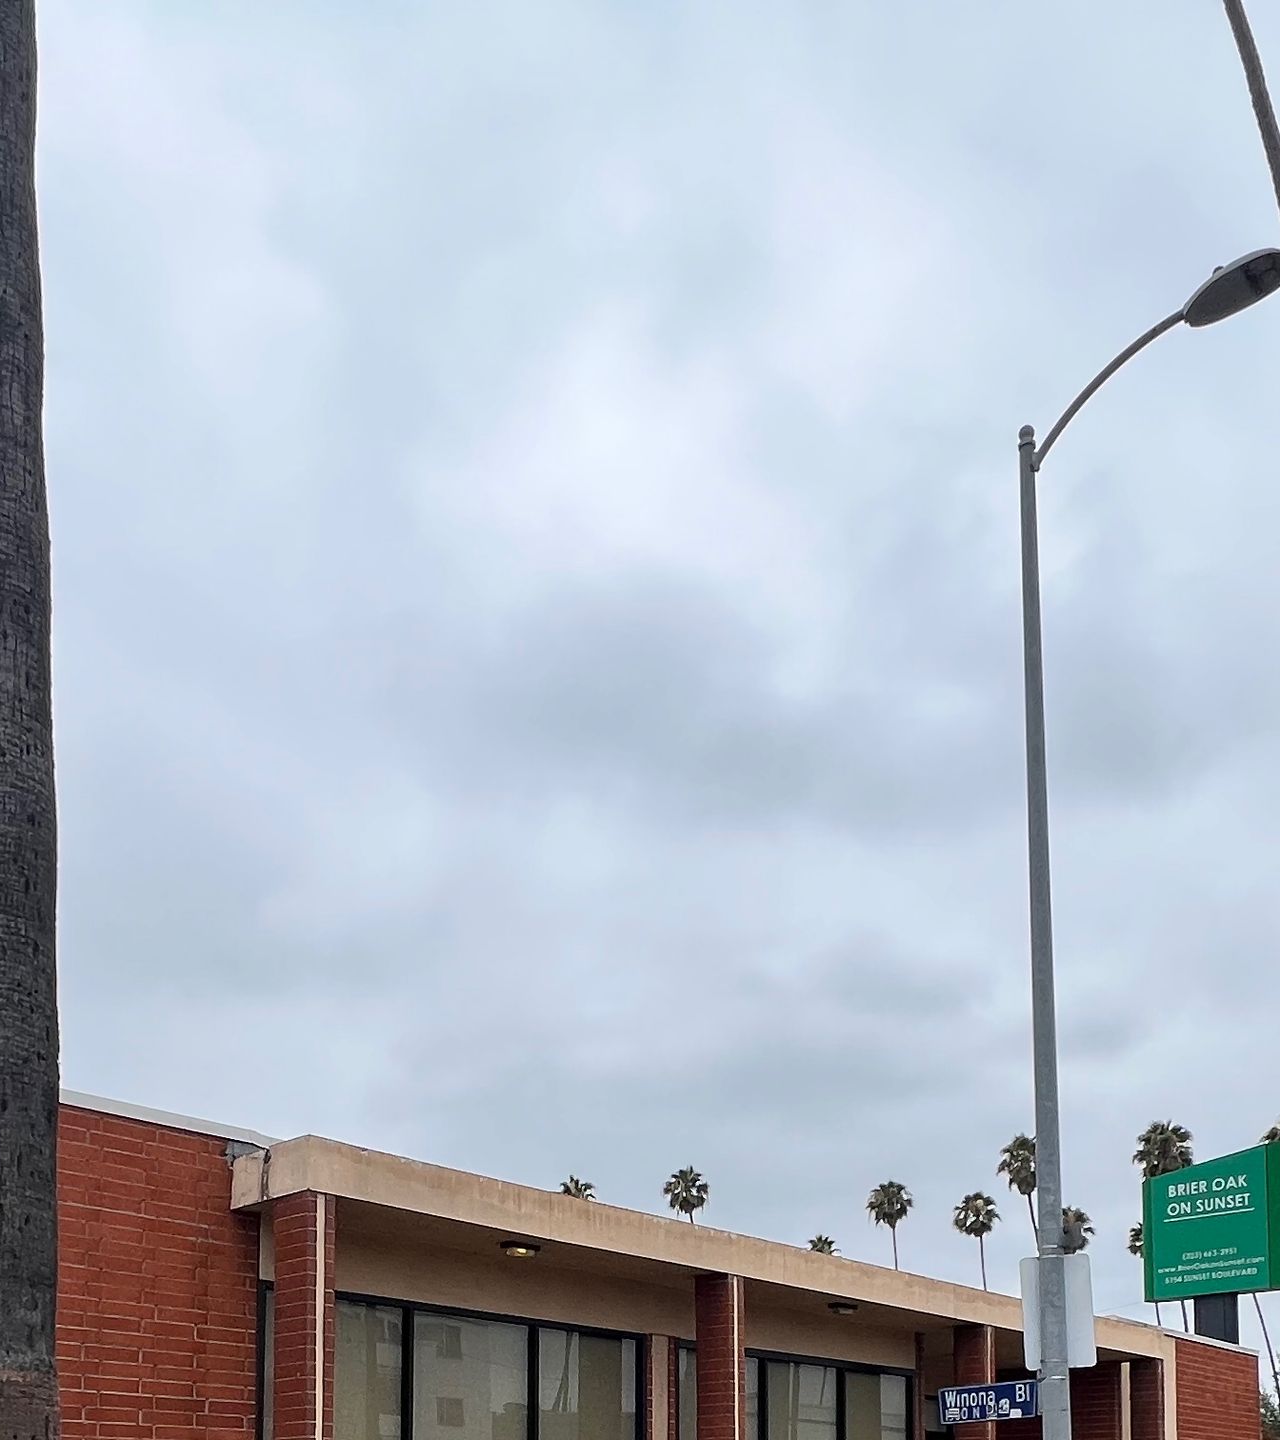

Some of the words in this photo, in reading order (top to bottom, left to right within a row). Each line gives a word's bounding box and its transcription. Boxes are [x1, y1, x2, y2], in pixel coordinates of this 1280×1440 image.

[1168, 1180, 1208, 1198] BRIER
[1212, 1174, 1248, 1191] OAK
[1167, 1202, 1191, 1216] ON
[1196, 1193, 1251, 1212] SUNSET
[1211, 1267, 1258, 1279] BOULEVARD
[944, 1391, 996, 1407] Winona
